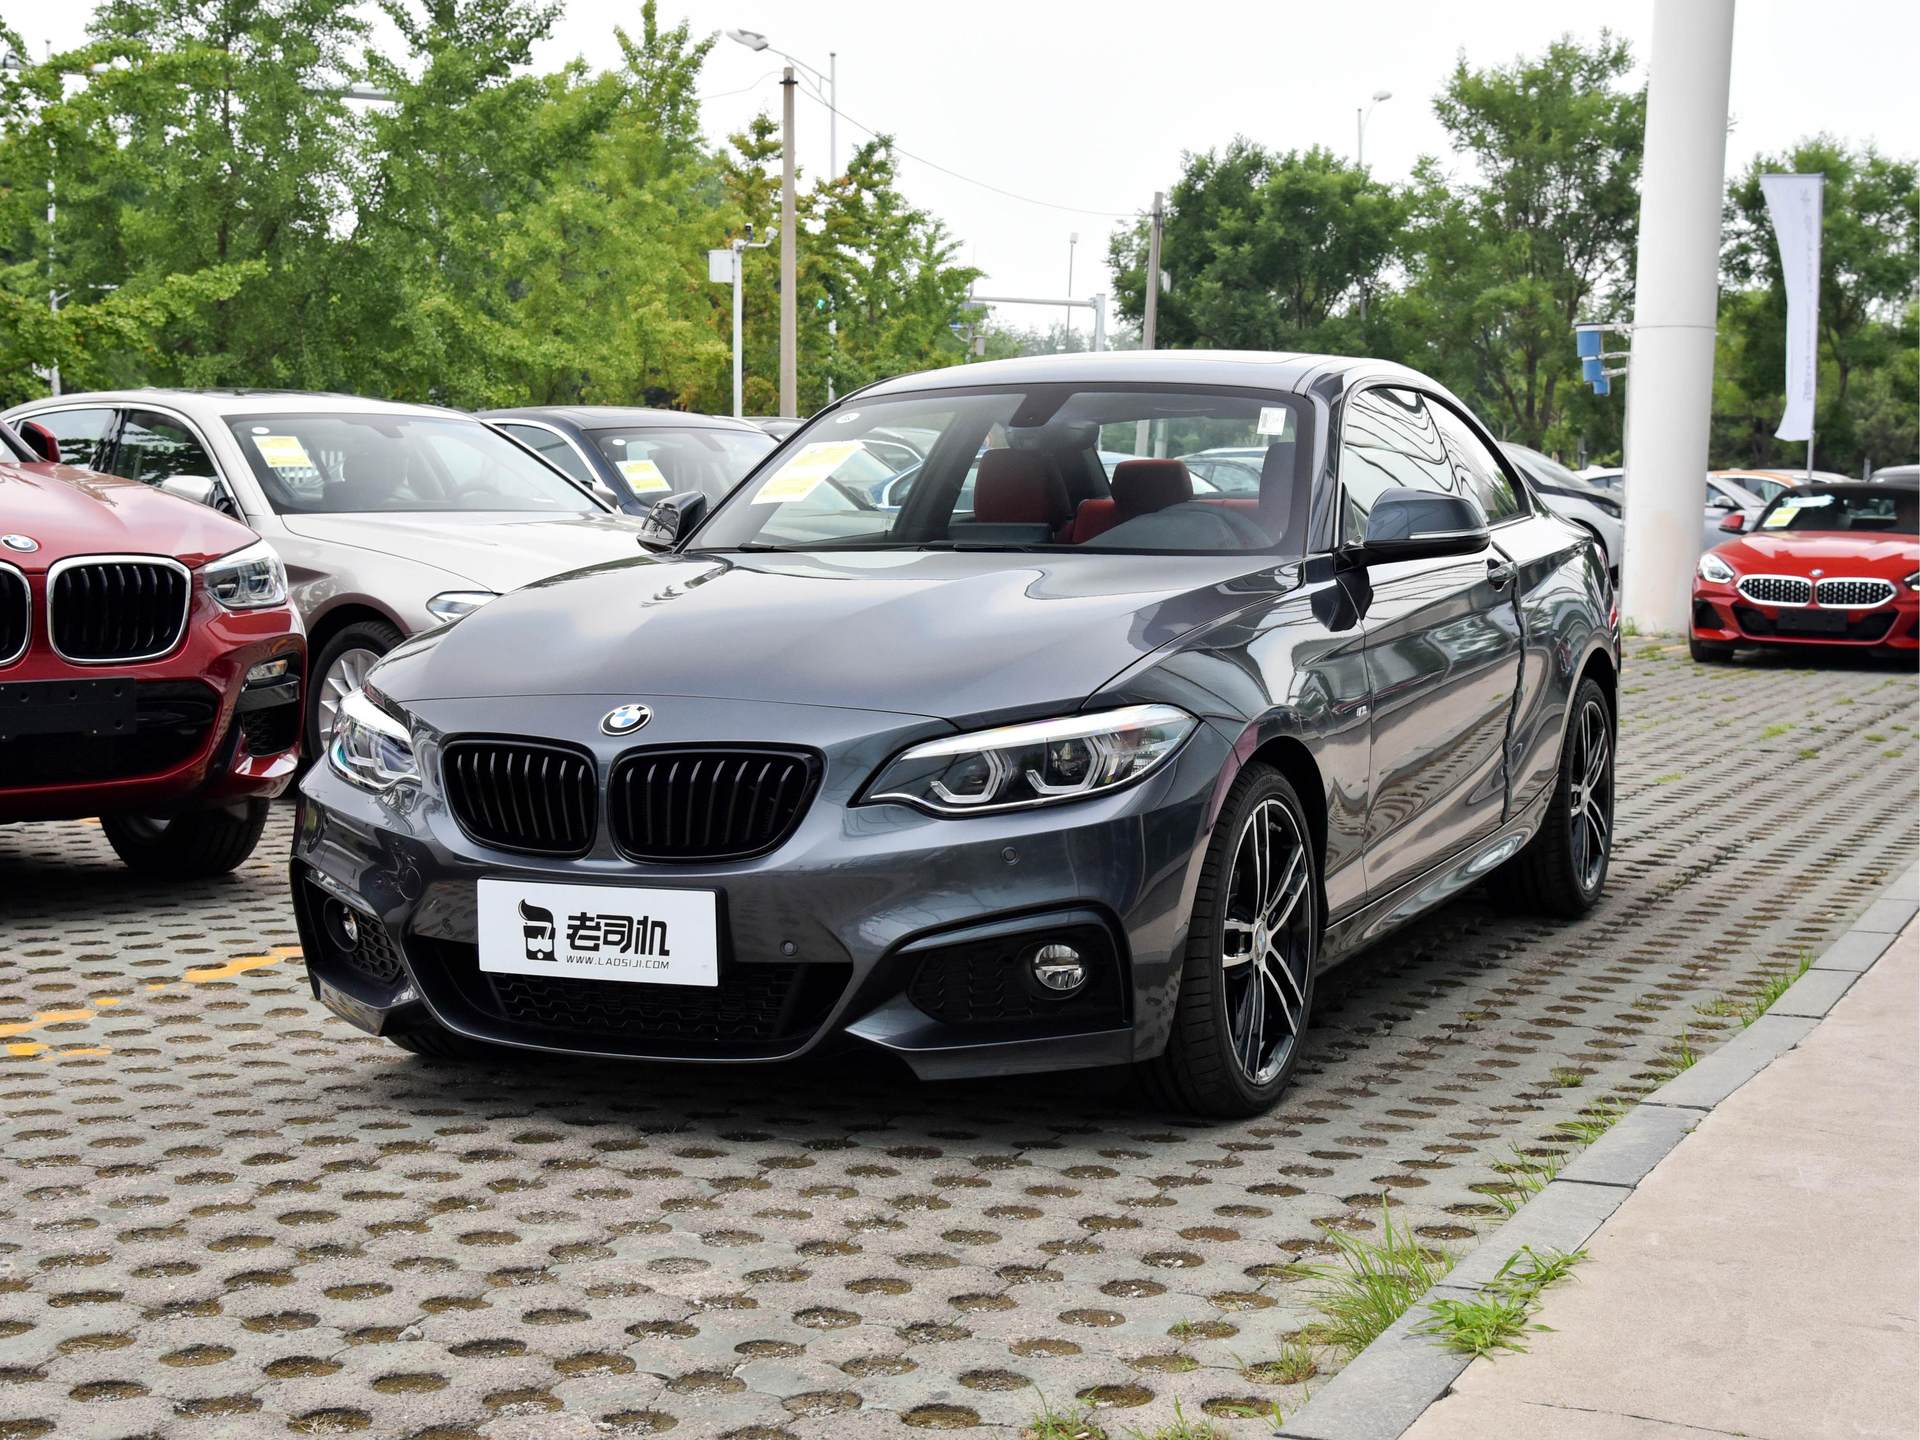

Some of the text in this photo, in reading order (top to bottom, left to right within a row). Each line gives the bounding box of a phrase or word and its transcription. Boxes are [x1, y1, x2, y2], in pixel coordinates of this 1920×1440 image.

[566, 912, 670, 957] 老司机
[566, 955, 670, 969] WWW.LAOSIJI.COM
